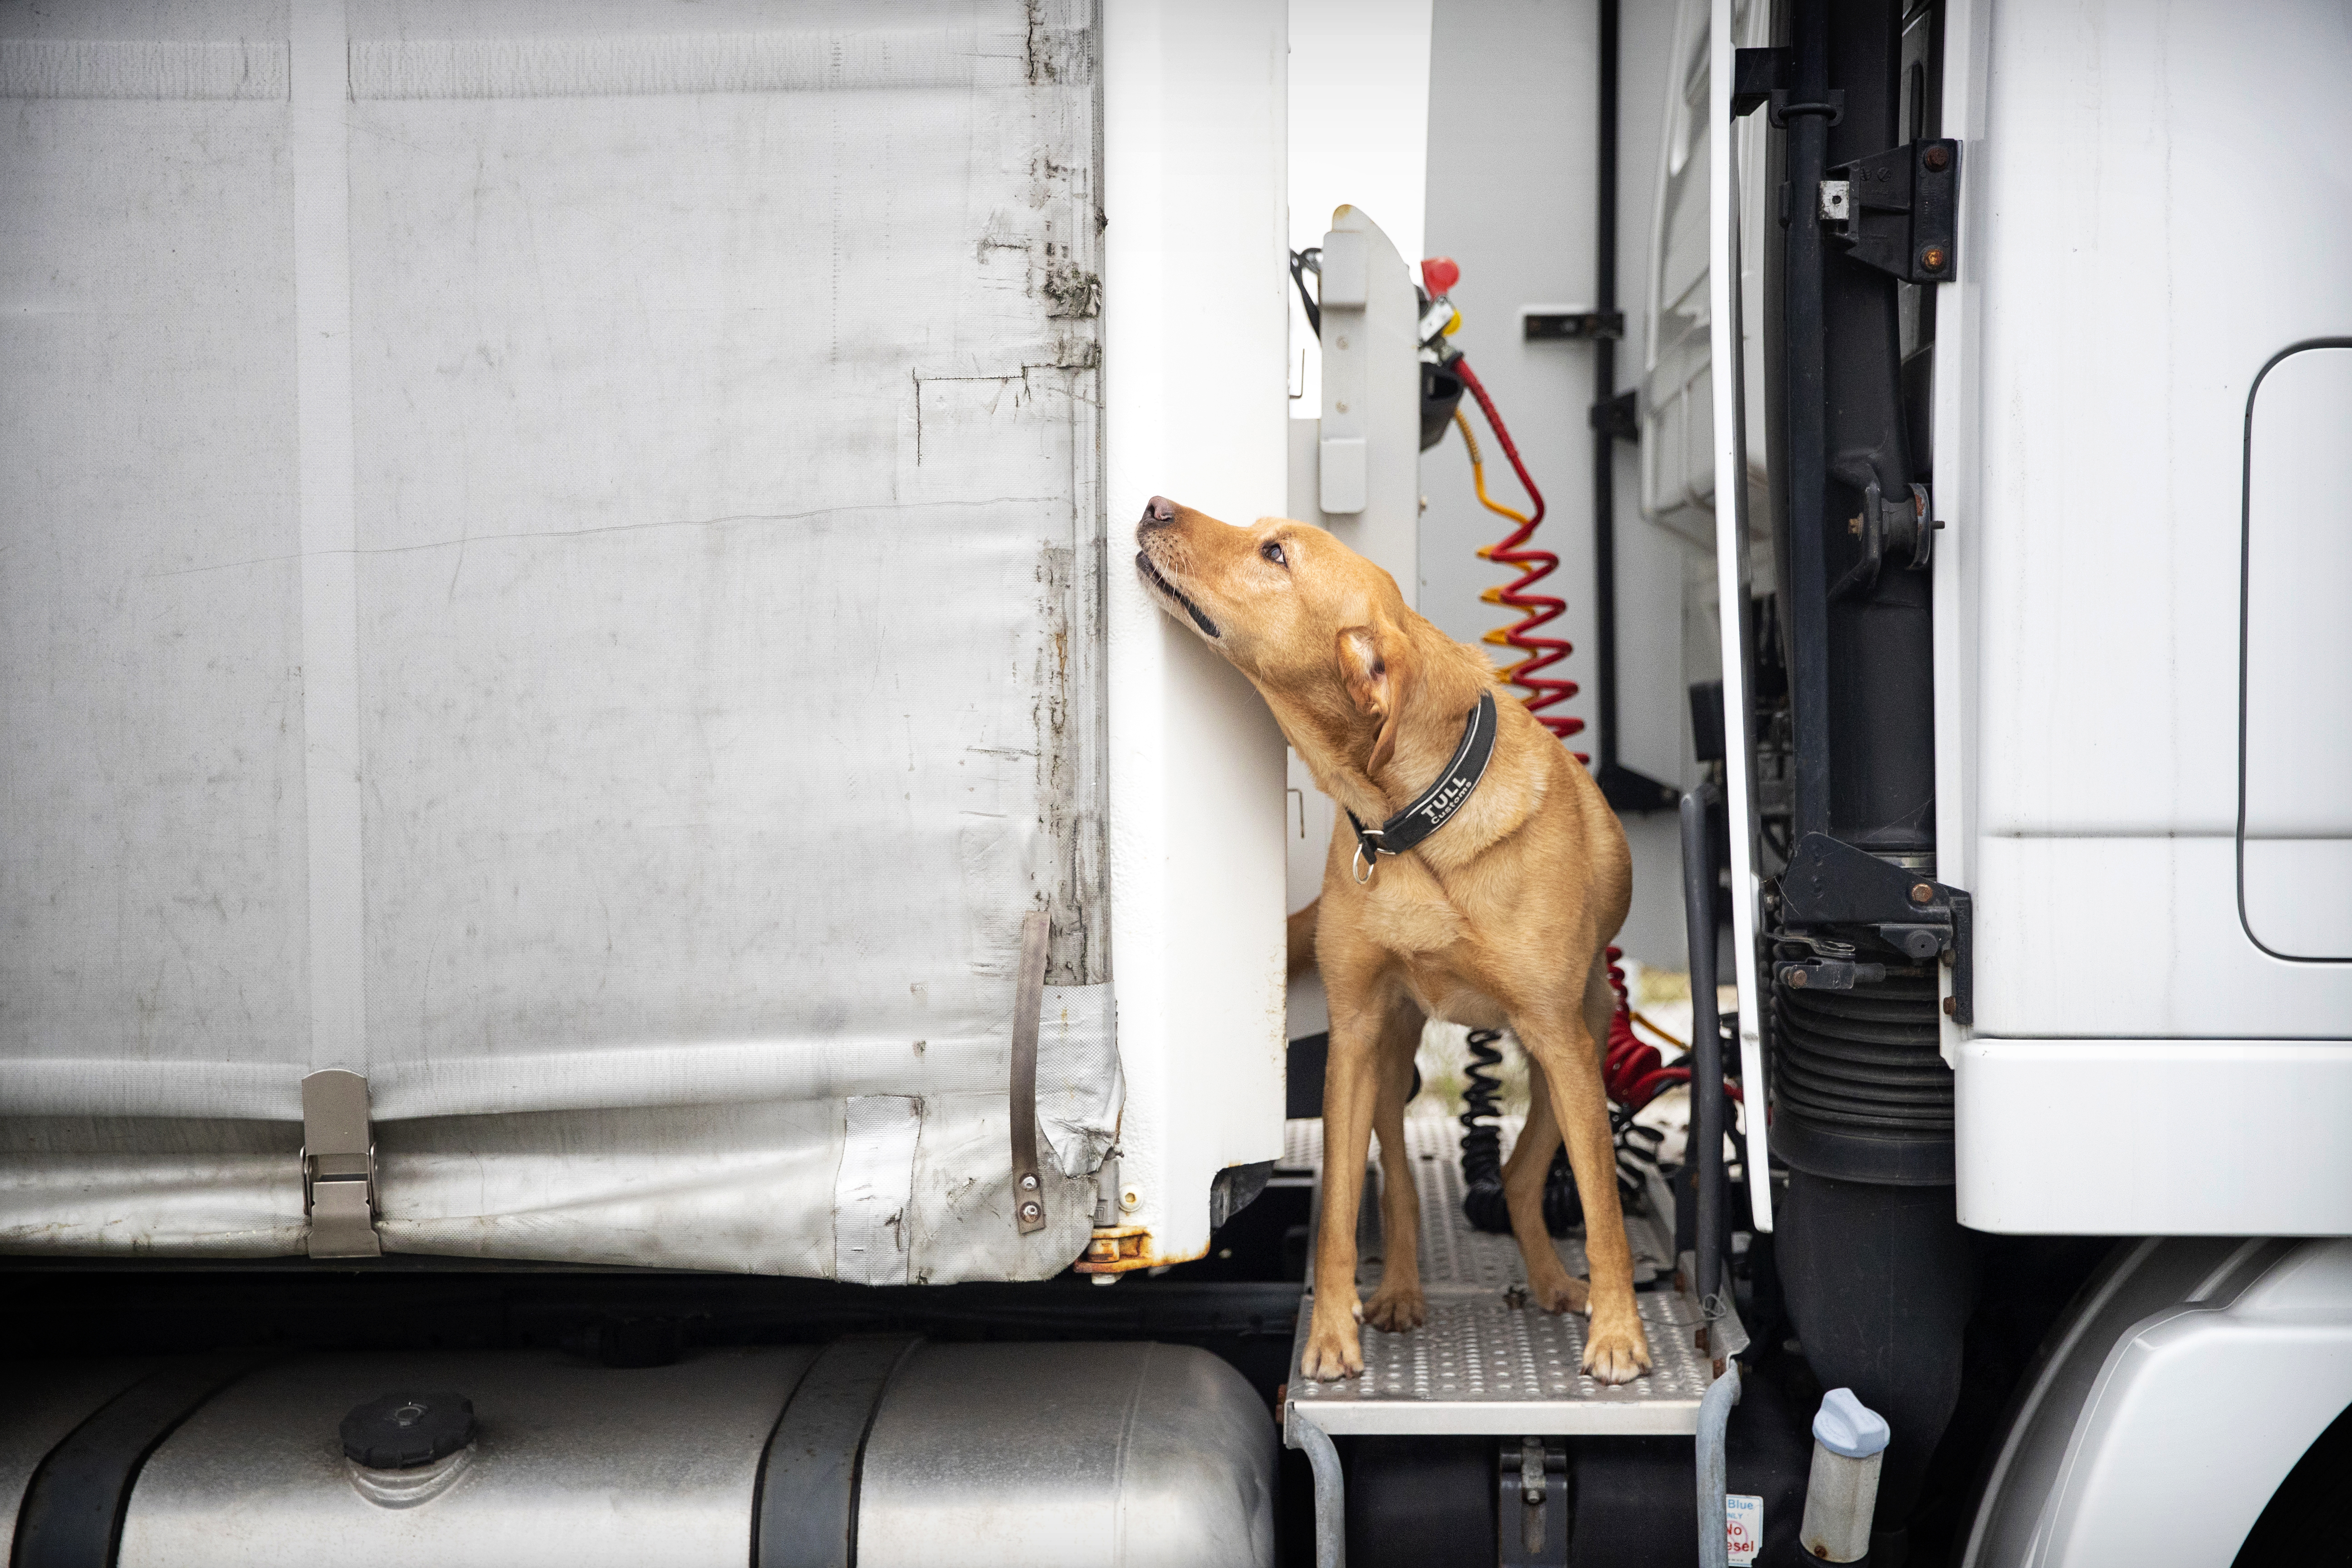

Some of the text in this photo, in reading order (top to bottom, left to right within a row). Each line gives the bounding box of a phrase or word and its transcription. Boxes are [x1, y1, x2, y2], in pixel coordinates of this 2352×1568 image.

[1421, 778, 1467, 818] TULL
[1431, 782, 1472, 824] Customs
[1727, 1540, 1754, 1552] esel
